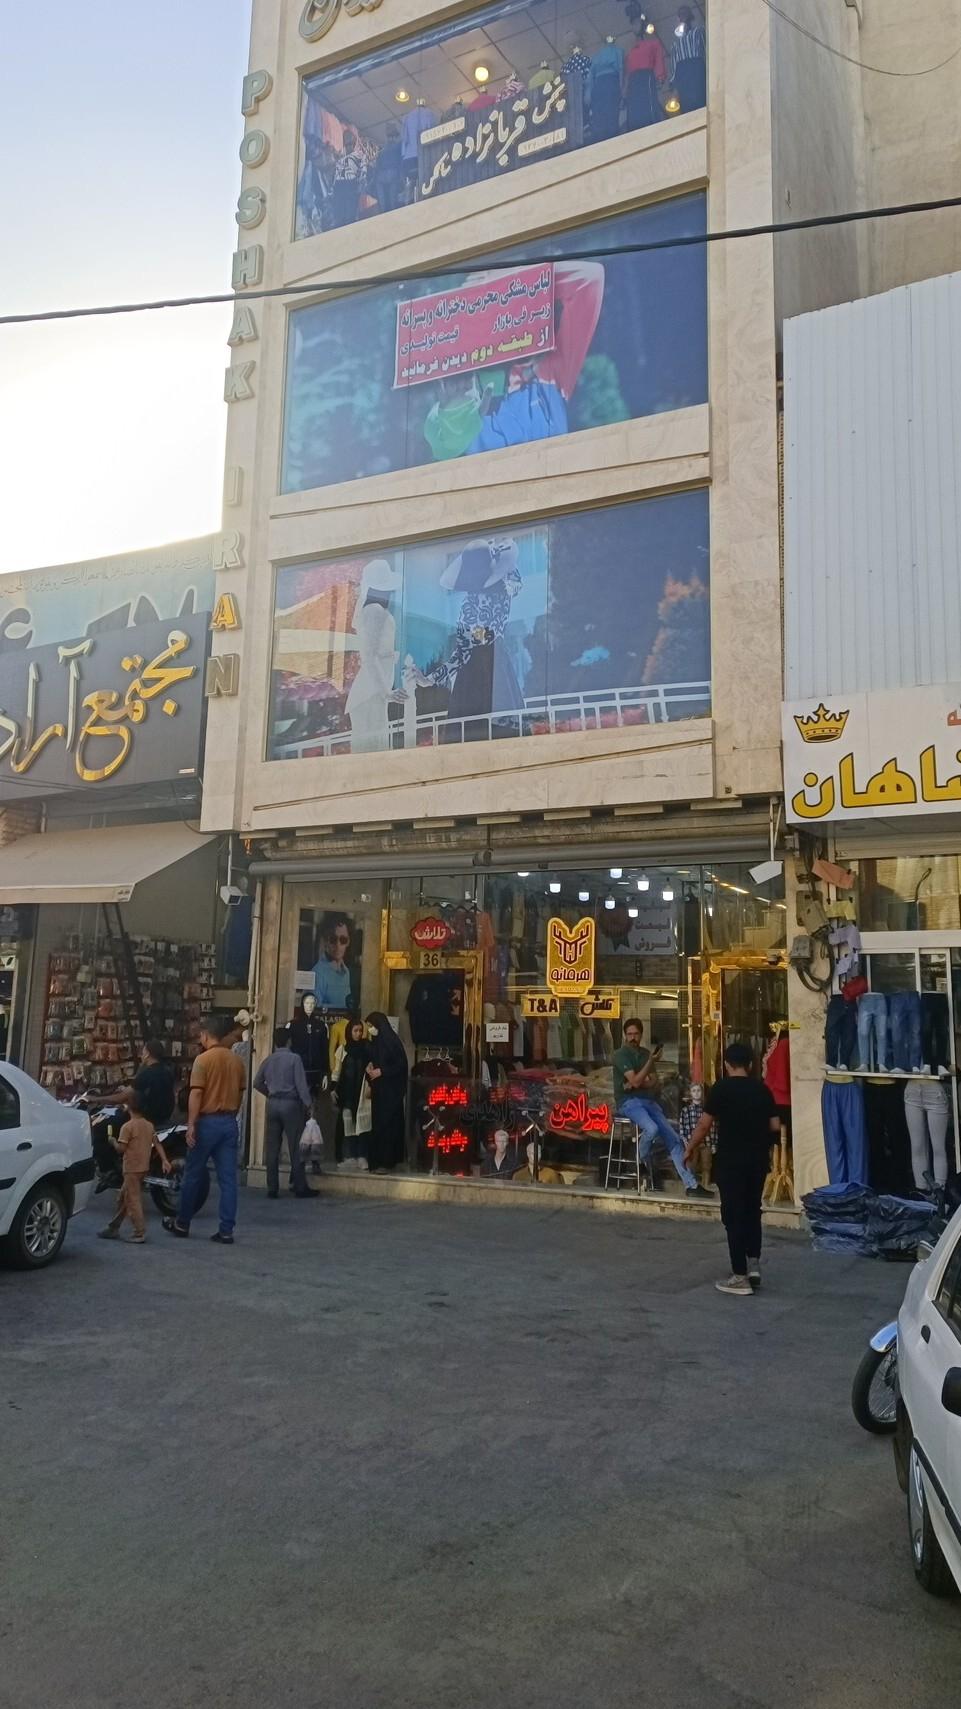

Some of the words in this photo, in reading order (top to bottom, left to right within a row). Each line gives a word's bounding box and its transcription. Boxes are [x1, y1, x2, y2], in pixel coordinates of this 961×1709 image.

[532, 76, 566, 124] پخش
[224, 70, 273, 405] POSHAK
[500, 279, 528, 305] مشکی
[528, 269, 551, 299] لباس
[435, 296, 467, 322] دخترانه
[467, 291, 500, 315] محرمی
[529, 303, 551, 323] زیر
[401, 308, 428, 331] پسرانه
[491, 312, 513, 334] بازار
[513, 306, 527, 326] فی
[437, 324, 460, 343] قیمت
[497, 331, 534, 352] طبقه
[537, 325, 549, 347] از
[400, 333, 437, 357] تولیدی
[470, 344, 494, 365] دوم
[442, 352, 467, 371] دیدن
[204, 464, 246, 700] IRAN
[76, 629, 197, 783] مجتمع
[414, 926, 446, 940] تلاش
[423, 953, 439, 968] 36
[528, 998, 559, 1013] T&A
[548, 1093, 610, 1134] پیراهن
